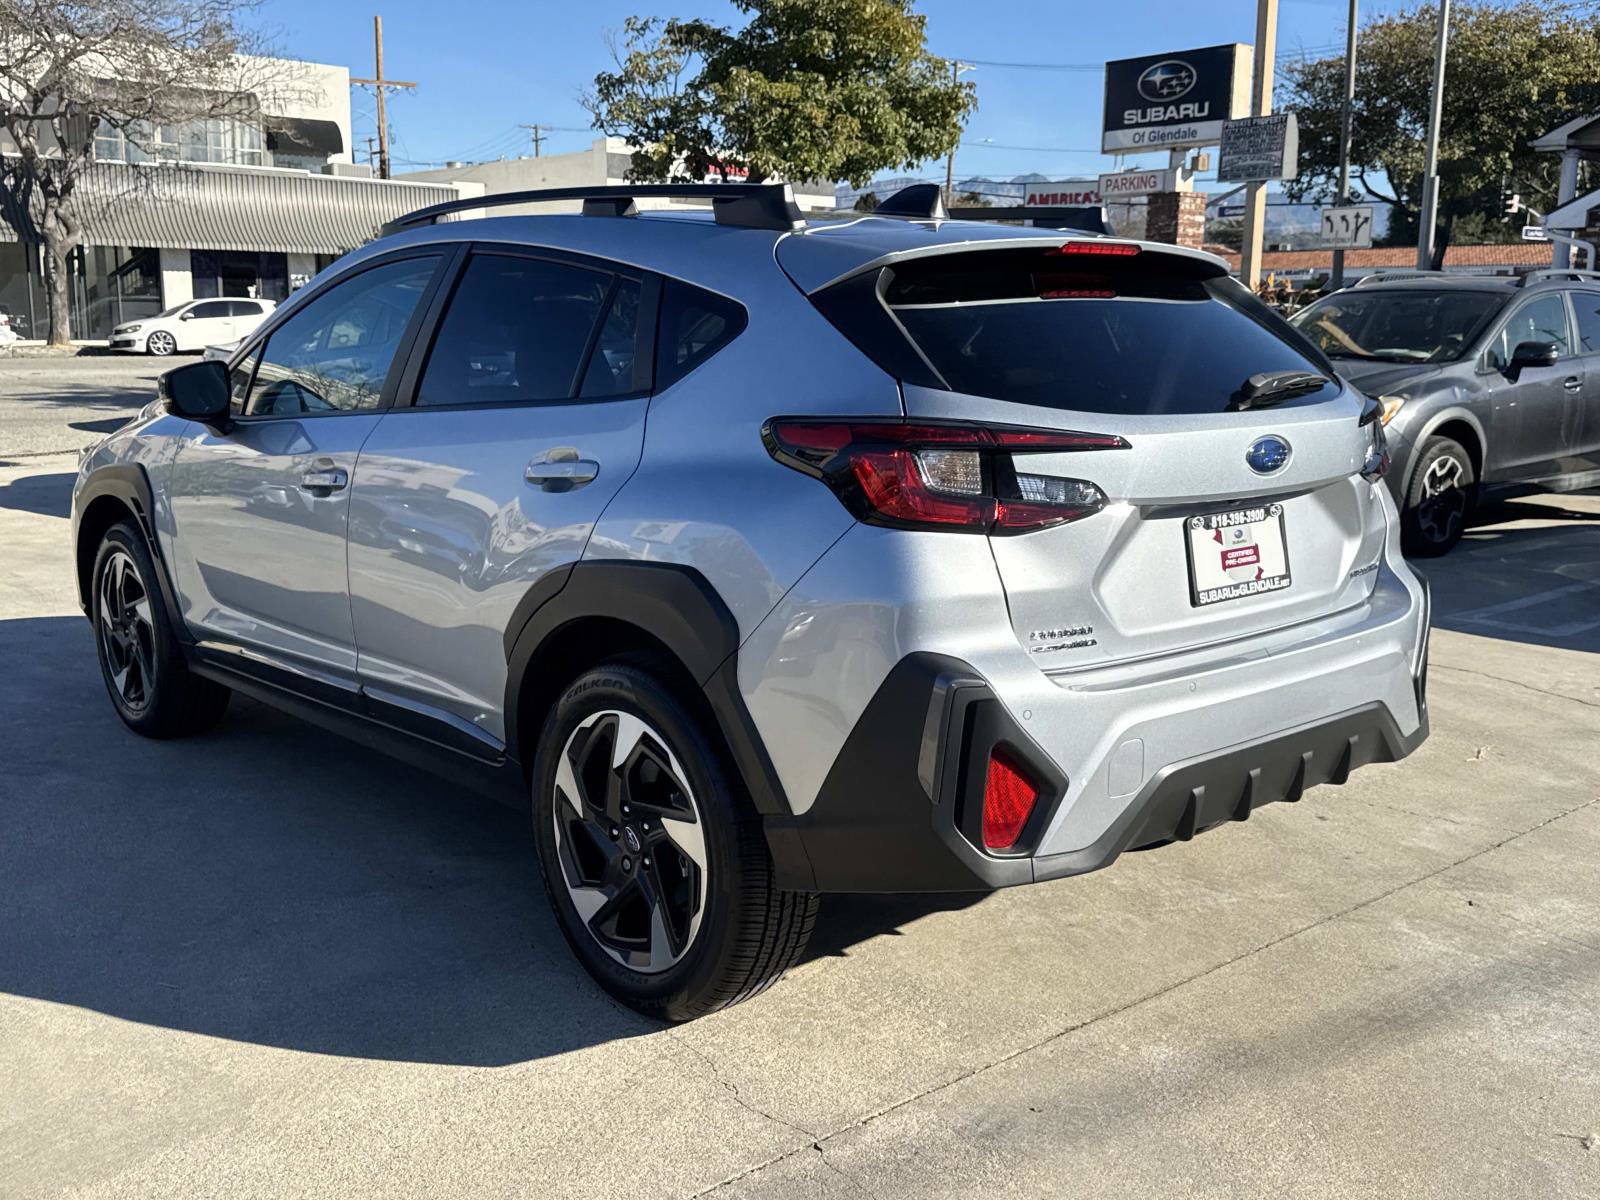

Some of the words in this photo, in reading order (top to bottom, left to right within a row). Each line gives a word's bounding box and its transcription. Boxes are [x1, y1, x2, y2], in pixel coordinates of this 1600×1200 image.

[1123, 101, 1210, 124] SUBARU
[1132, 131, 1145, 144] Of
[1148, 128, 1198, 143] Glendale
[1105, 174, 1157, 192] PARKING
[1027, 190, 1102, 205] AMERICA'S
[1225, 555, 1257, 567] PRE-OWNED
[1227, 548, 1254, 559] CERTIFIED
